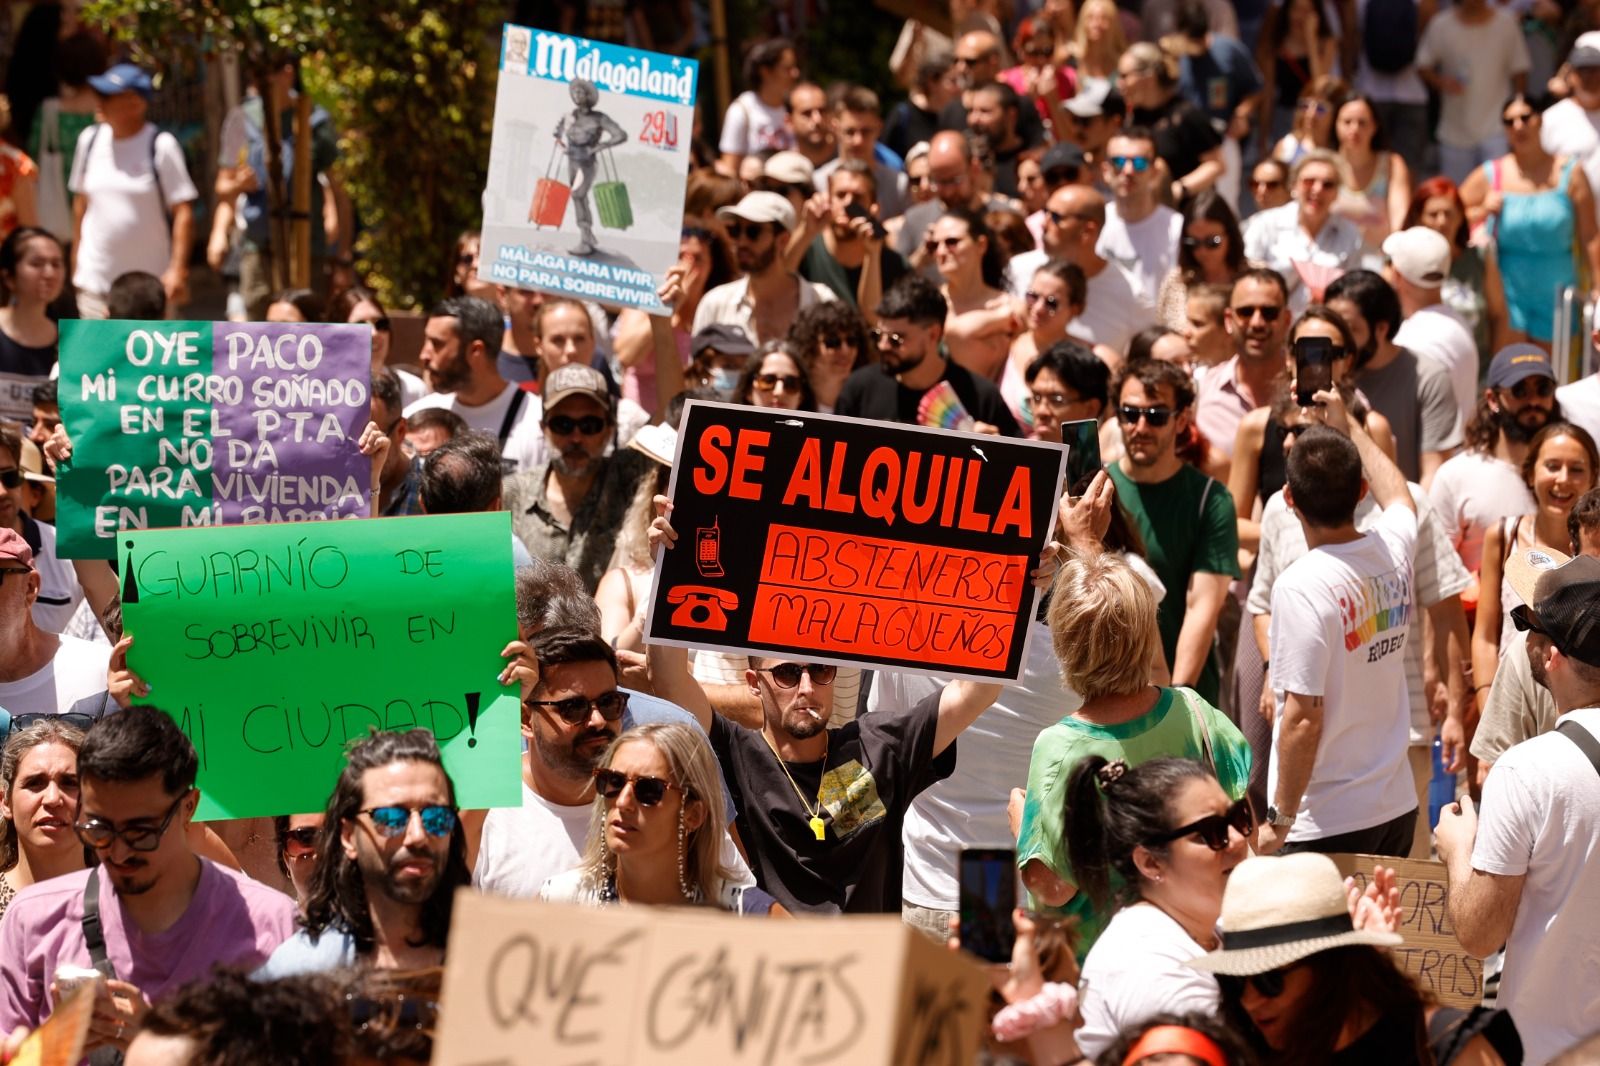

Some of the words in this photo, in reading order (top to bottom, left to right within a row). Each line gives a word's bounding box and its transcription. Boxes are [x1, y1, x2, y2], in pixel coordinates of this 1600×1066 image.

[535, 32, 694, 101] Málagaland
[639, 110, 678, 147] 29J
[493, 264, 518, 279] NO
[518, 270, 561, 288] PARA
[500, 245, 566, 271] MÁLAGA
[568, 258, 610, 279] PARA
[612, 267, 655, 288] VIVIR.
[125, 330, 201, 366] OYE
[225, 332, 323, 371] PACO
[137, 374, 243, 403] CURRO
[252, 374, 366, 408] SOÑADO
[121, 405, 164, 435] EN
[183, 409, 232, 438] EL
[159, 437, 213, 470] NO
[227, 439, 279, 470] DA
[106, 464, 202, 499] PARA
[692, 424, 772, 501] SE
[781, 438, 1032, 539] ALQUILA
[94, 506, 148, 538] EN
[395, 549, 444, 577] DE
[769, 531, 1022, 605] ABSTENERSE
[407, 611, 455, 643] EN
[769, 593, 1014, 660] MALAGUEÑOS
